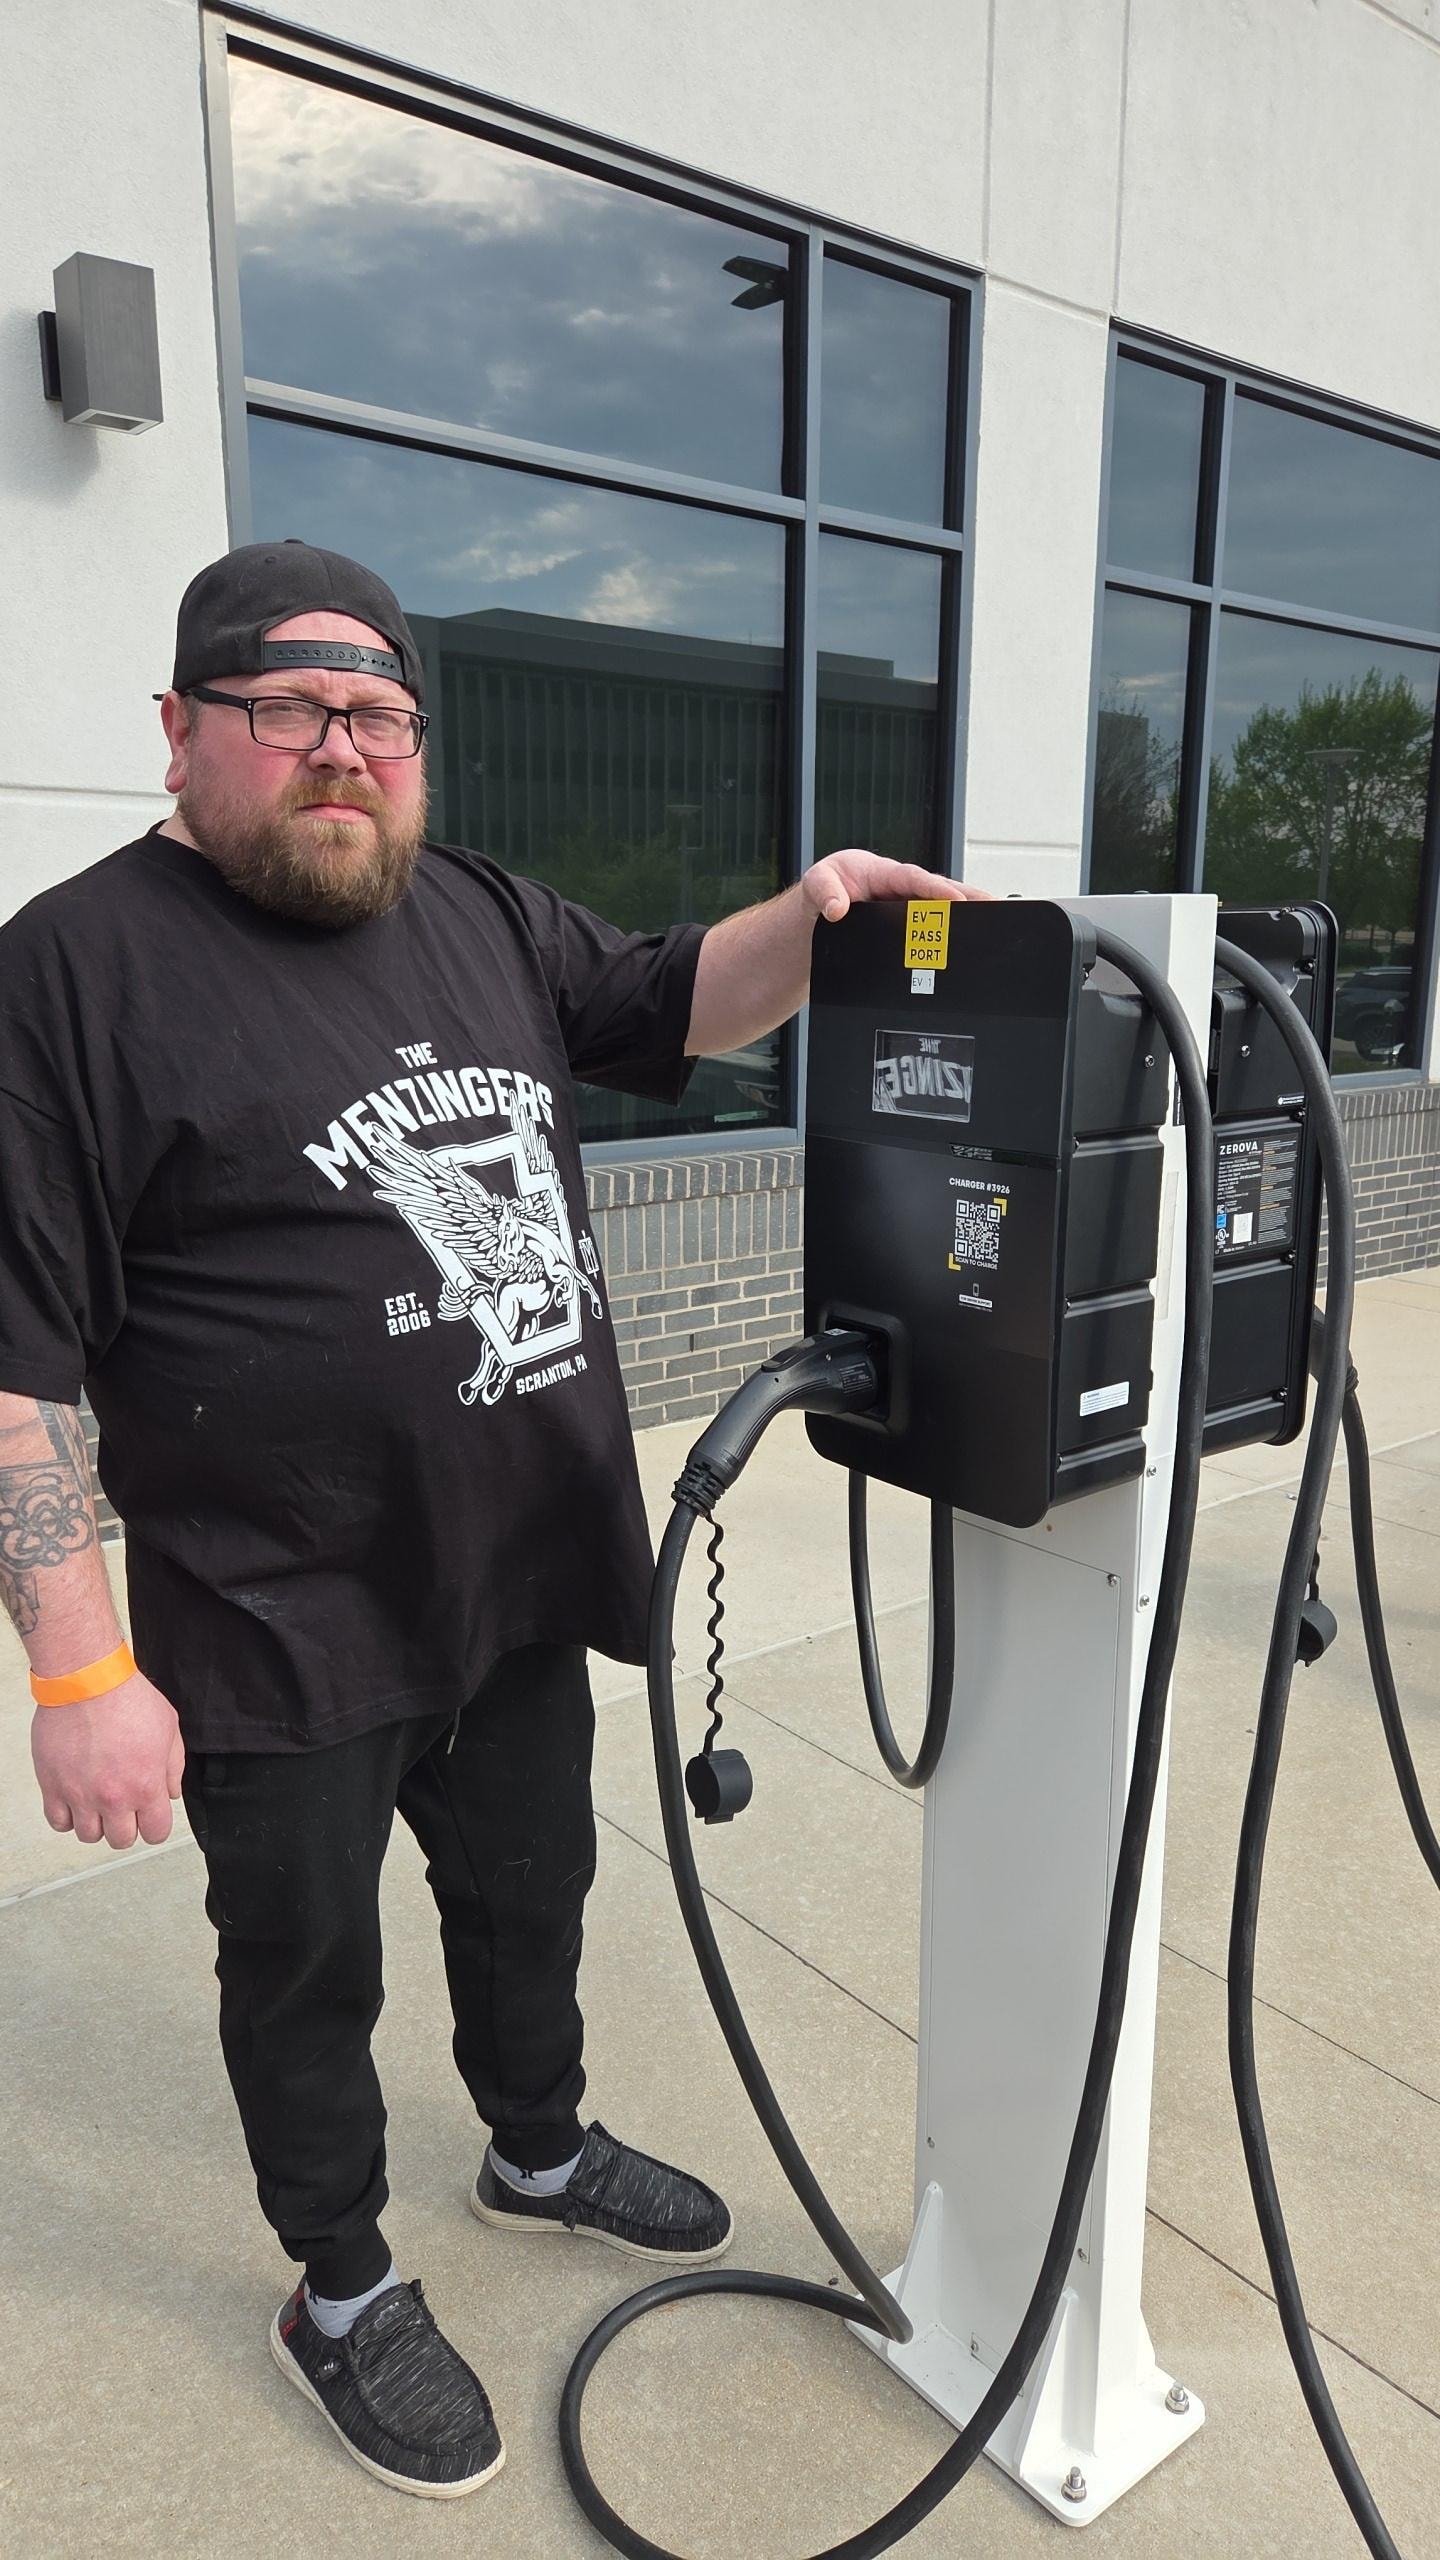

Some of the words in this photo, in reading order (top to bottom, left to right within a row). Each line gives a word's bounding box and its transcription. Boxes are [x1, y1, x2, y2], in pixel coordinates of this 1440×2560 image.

[912, 911, 927, 923] EV
[911, 930, 942, 942] PASS
[910, 948, 941, 961] PORT
[912, 977, 923, 987] EV
[395, 1042, 437, 1069] THE
[303, 1067, 555, 1191] MENZINGERS
[1219, 1141, 1258, 1155] ZEROVA
[949, 1177, 985, 1191] CHARGER
[986, 1183, 1010, 1194] #3926
[955, 1256, 969, 1265] SCAN
[977, 1260, 998, 1270] CHARGE
[384, 1292, 424, 1317] EST.
[386, 1310, 431, 1336] 2006
[516, 1360, 576, 1395] SCRANTON,
[575, 1354, 588, 1371] PA
